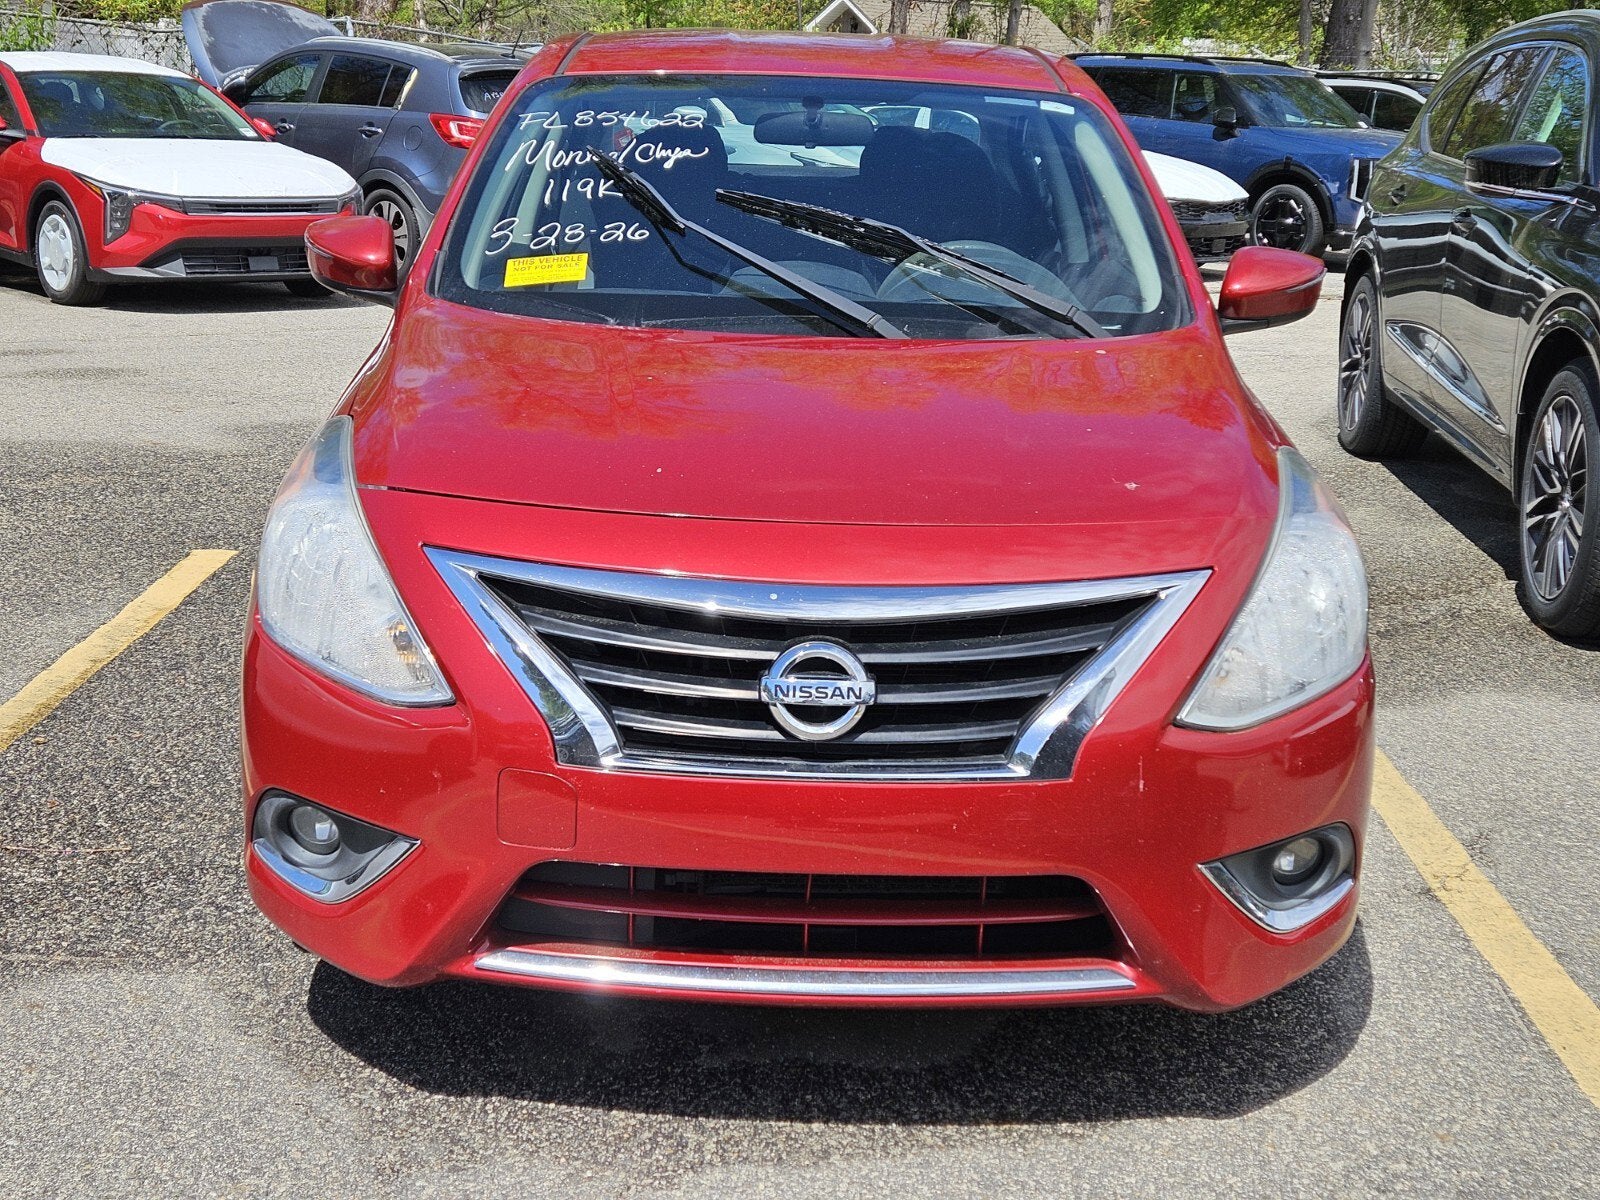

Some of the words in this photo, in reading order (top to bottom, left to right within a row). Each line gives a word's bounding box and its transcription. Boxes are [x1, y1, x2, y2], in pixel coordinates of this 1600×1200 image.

[574, 110, 704, 130] 854622
[544, 178, 624, 204] 119K
[485, 217, 650, 255] 3-28-26
[512, 258, 535, 267] THIS
[538, 255, 584, 264] VEHICLE
[774, 684, 862, 700] NISSAN
